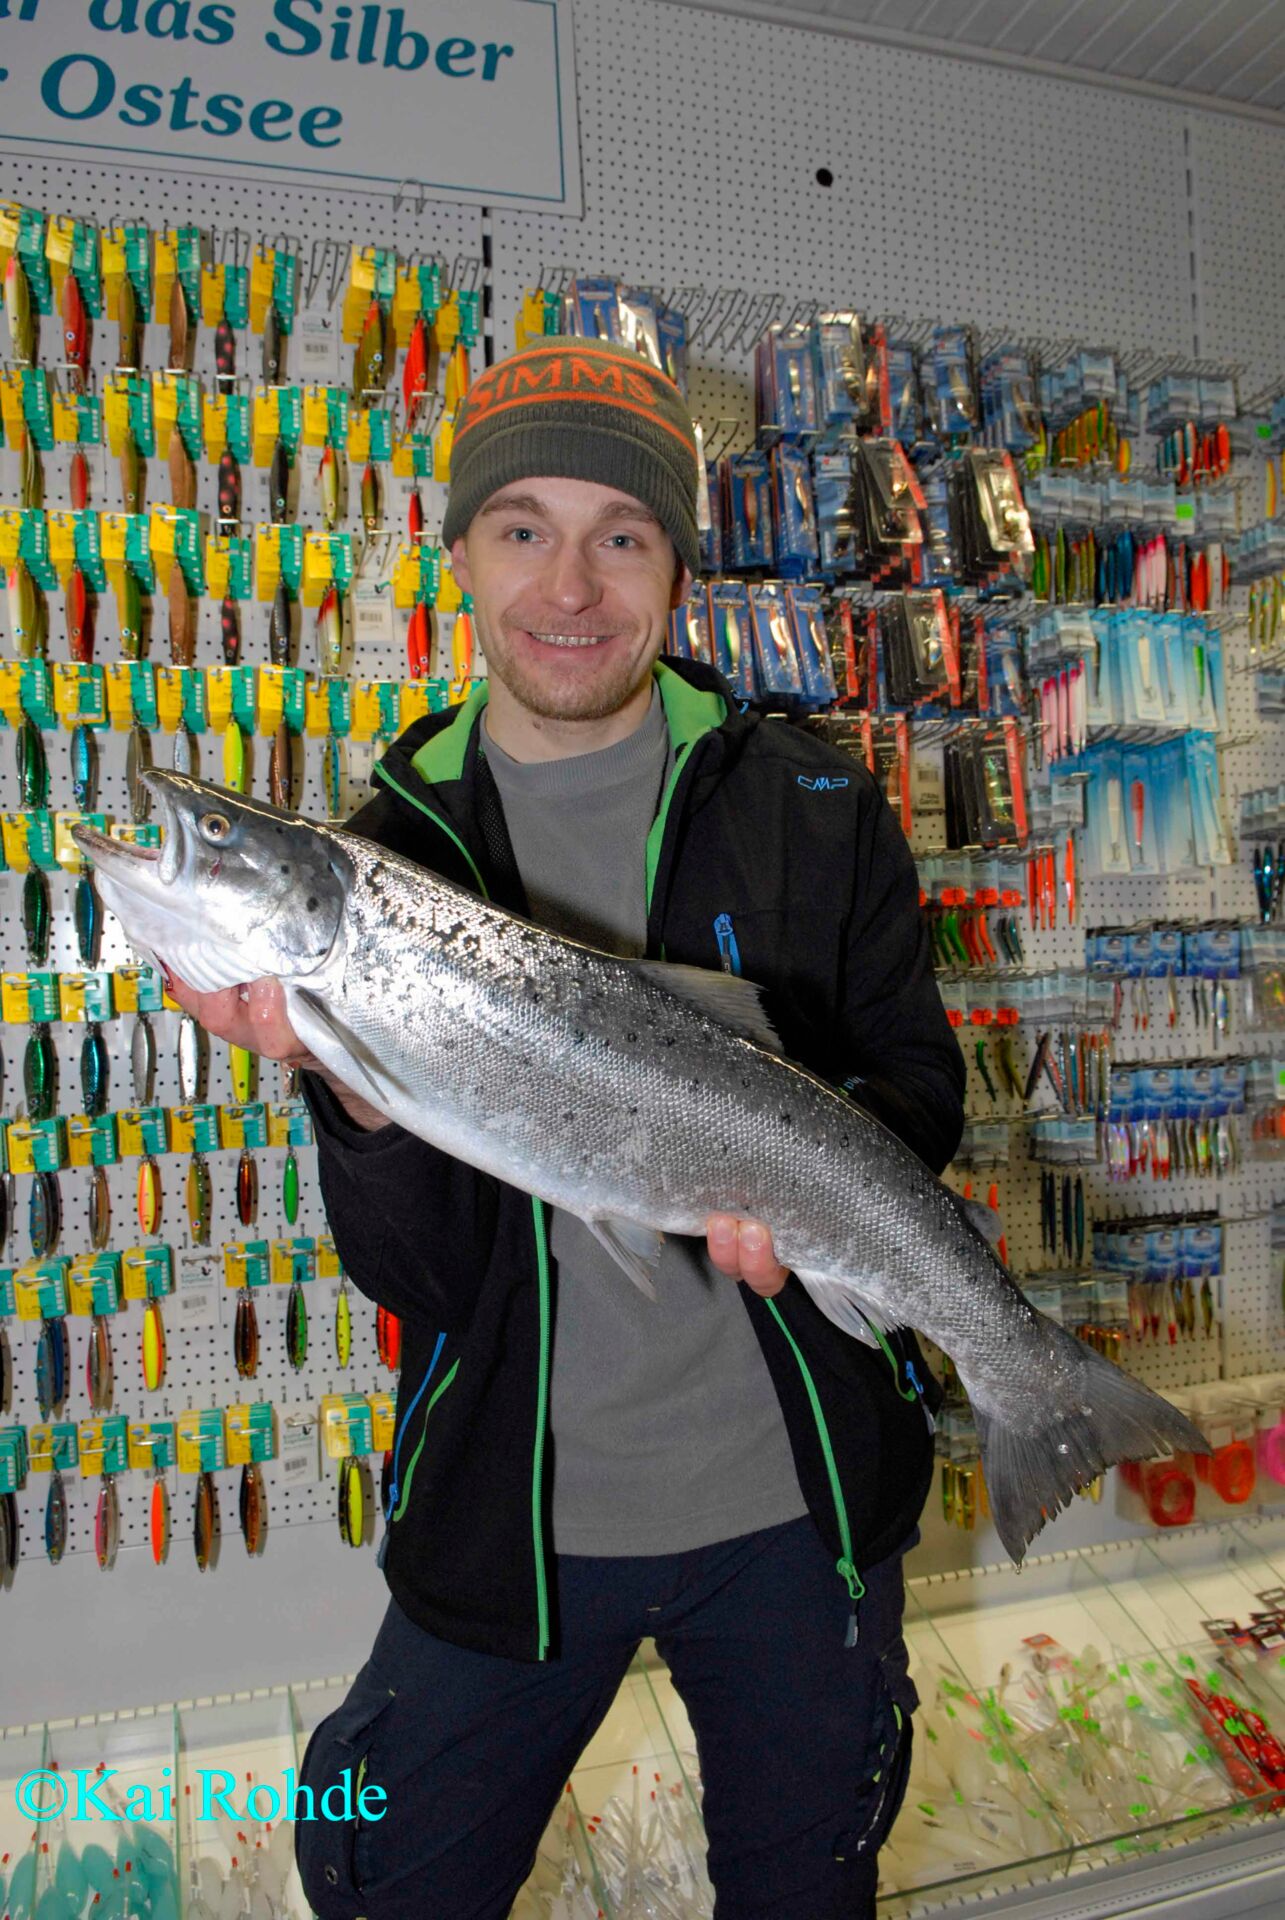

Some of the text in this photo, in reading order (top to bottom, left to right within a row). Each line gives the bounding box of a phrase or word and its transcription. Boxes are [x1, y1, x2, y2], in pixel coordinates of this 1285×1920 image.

[88, 0, 514, 81] das Silber
[40, 53, 343, 148] Ostsee
[466, 357, 657, 422] SIMMS
[797, 774, 849, 791] CMP
